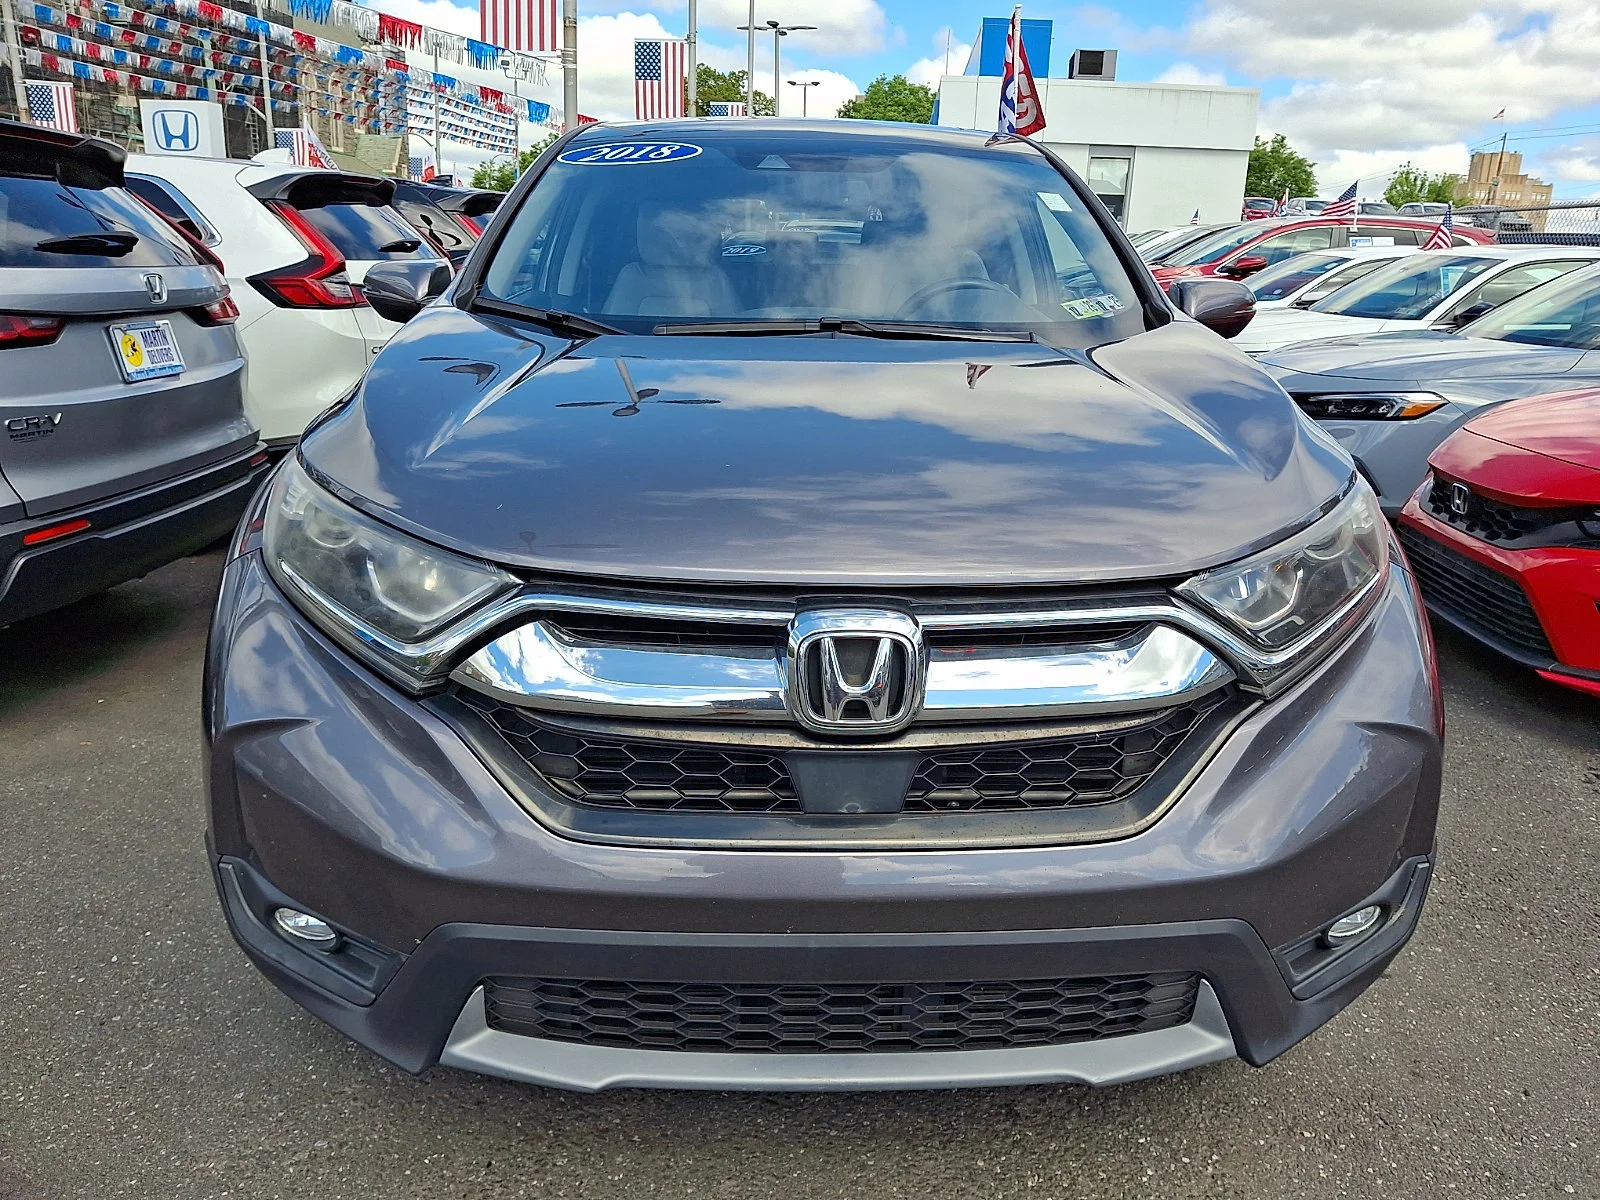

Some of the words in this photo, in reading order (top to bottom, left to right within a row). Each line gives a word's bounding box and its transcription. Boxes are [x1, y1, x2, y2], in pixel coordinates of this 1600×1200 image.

[577, 145, 681, 162] 2018
[140, 328, 170, 349] MARTIN
[146, 347, 175, 365] DELIVERS
